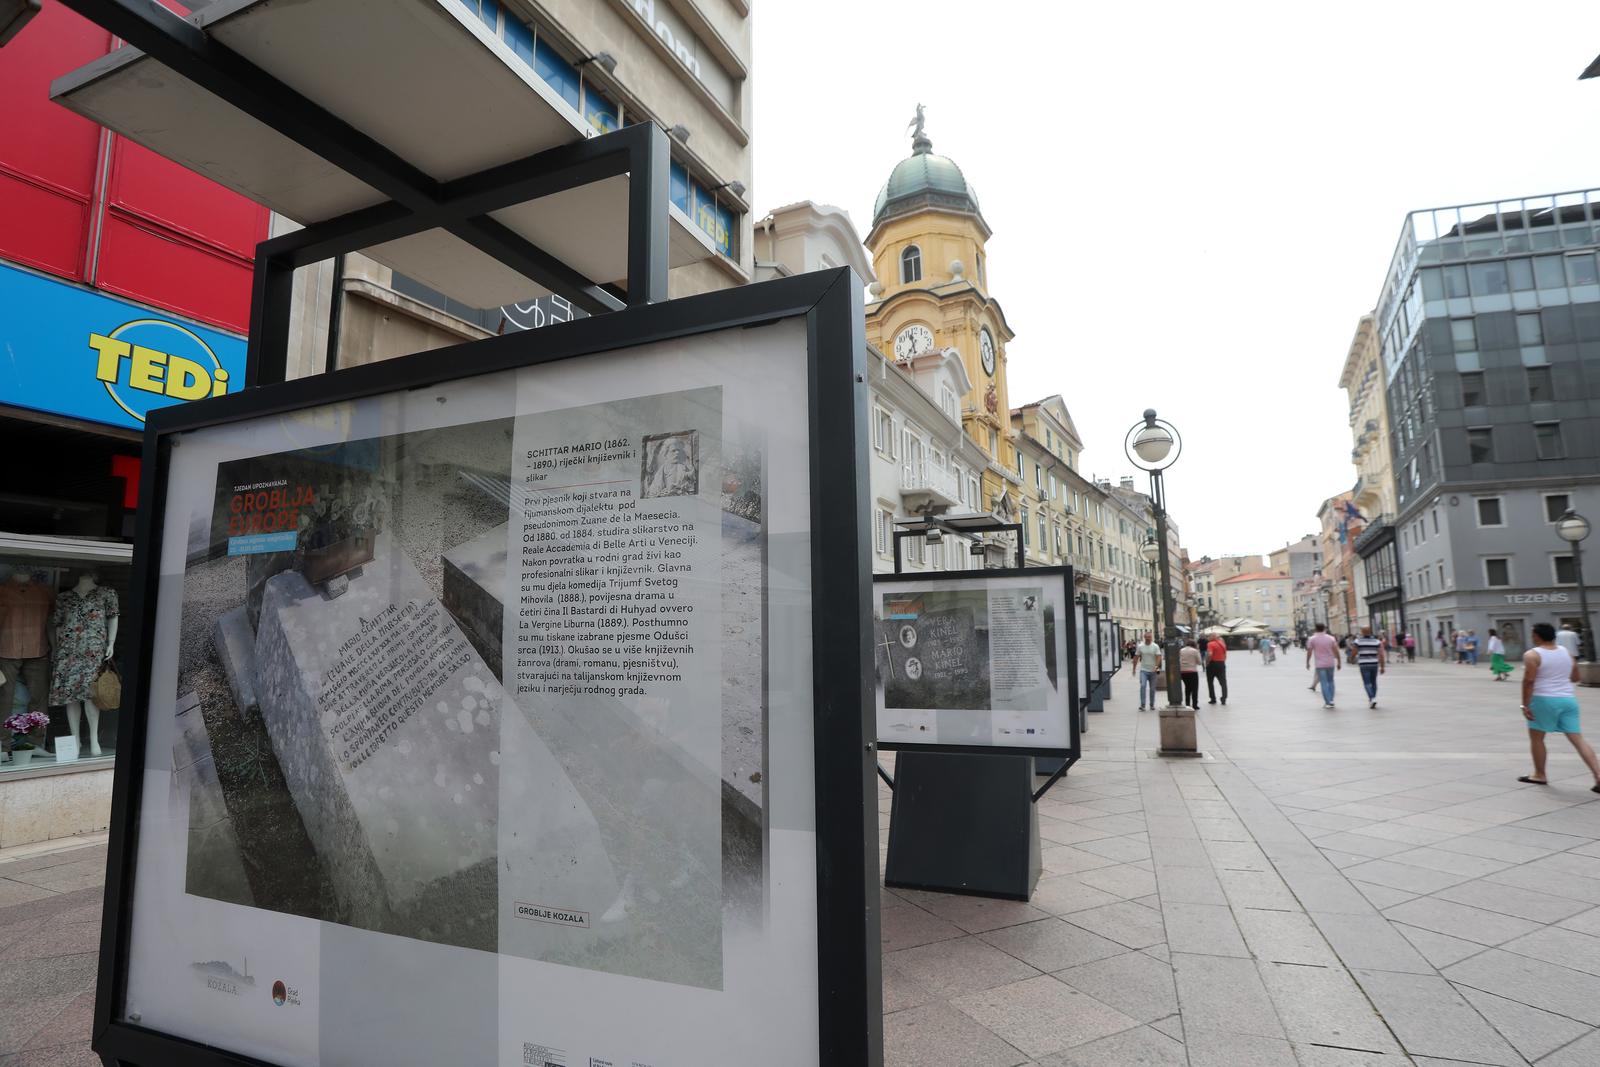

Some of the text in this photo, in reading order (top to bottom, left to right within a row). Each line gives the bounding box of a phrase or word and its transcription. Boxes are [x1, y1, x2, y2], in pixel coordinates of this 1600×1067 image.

[89, 332, 230, 401] TEDi
[528, 439, 630, 459] SCHITTAR MARIO (1862.
[533, 450, 636, 470] 1890.) riječki književnik i
[525, 473, 547, 483] slikar
[231, 486, 315, 513] GROBLJA
[525, 489, 631, 506] Prvi pjesnik koji stvara na
[524, 501, 635, 519] fijumanskom dijalektu pod
[228, 510, 298, 534] EUROPE
[523, 520, 578, 532] pseudonimom
[581, 517, 607, 525] Zuane
[610, 515, 620, 523] de
[634, 511, 680, 521] Maesecia.
[523, 534, 534, 542] Od
[537, 533, 557, 541] 1880.
[573, 530, 594, 539] 1884.
[598, 528, 629, 537] studira
[632, 525, 679, 534] slikarstvo
[682, 523, 694, 531] na
[523, 546, 544, 555] Reale
[546, 543, 590, 553] Accademia
[593, 541, 601, 550] di
[603, 540, 625, 549] Belle
[629, 539, 646, 547] Arti
[658, 537, 698, 547] Veneciji.
[522, 559, 547, 567] Nakon
[550, 556, 585, 567] povratka
[595, 554, 619, 562] rodni
[622, 552, 643, 561] grad
[646, 551, 661, 560] živi
[664, 551, 681, 559] kao
[522, 569, 574, 580] profesionalni
[576, 568, 599, 577] slikar
[607, 565, 654, 576] književnik.
[657, 564, 691, 573] Glavna
[547, 581, 566, 592] djela
[568, 580, 606, 591] komedija
[609, 579, 642, 590] Trijumf
[645, 578, 678, 588] Svetog
[521, 595, 553, 604] Mihovila
[589, 592, 632, 603] povijesna
[634, 592, 665, 601] drama
[520, 604, 693, 616] četiri čina Il Bastardi di Huhyad ovvero
[337, 632, 362, 656] MARIO
[360, 602, 397, 636] SCHITTAR
[358, 616, 369, 628] A
[520, 621, 529, 629] La
[532, 620, 561, 631] Vergine
[564, 619, 595, 628] Liburna
[632, 618, 688, 627] Posthumno
[354, 633, 378, 655] DELLA
[531, 634, 544, 642] mu
[547, 633, 575, 642] tiskane
[577, 632, 614, 641] izabrane
[617, 632, 650, 643] pjesme
[653, 631, 688, 640] Odušci
[568, 645, 600, 654] Okušao
[623, 645, 642, 654] više
[645, 645, 694, 658] književnih
[518, 658, 551, 667] žanrova
[517, 672, 559, 682] stvarajući
[574, 671, 624, 684] talijanskom
[627, 672, 682, 684] književnom
[390, 681, 405, 696] DEL
[396, 697, 424, 725] QUESTO
[422, 672, 449, 700] MEMORE
[448, 652, 471, 674] SASSO
[517, 684, 647, 696] jeziku i narječju rodnog grada.
[518, 906, 584, 924] GROBLJE KOZALA
